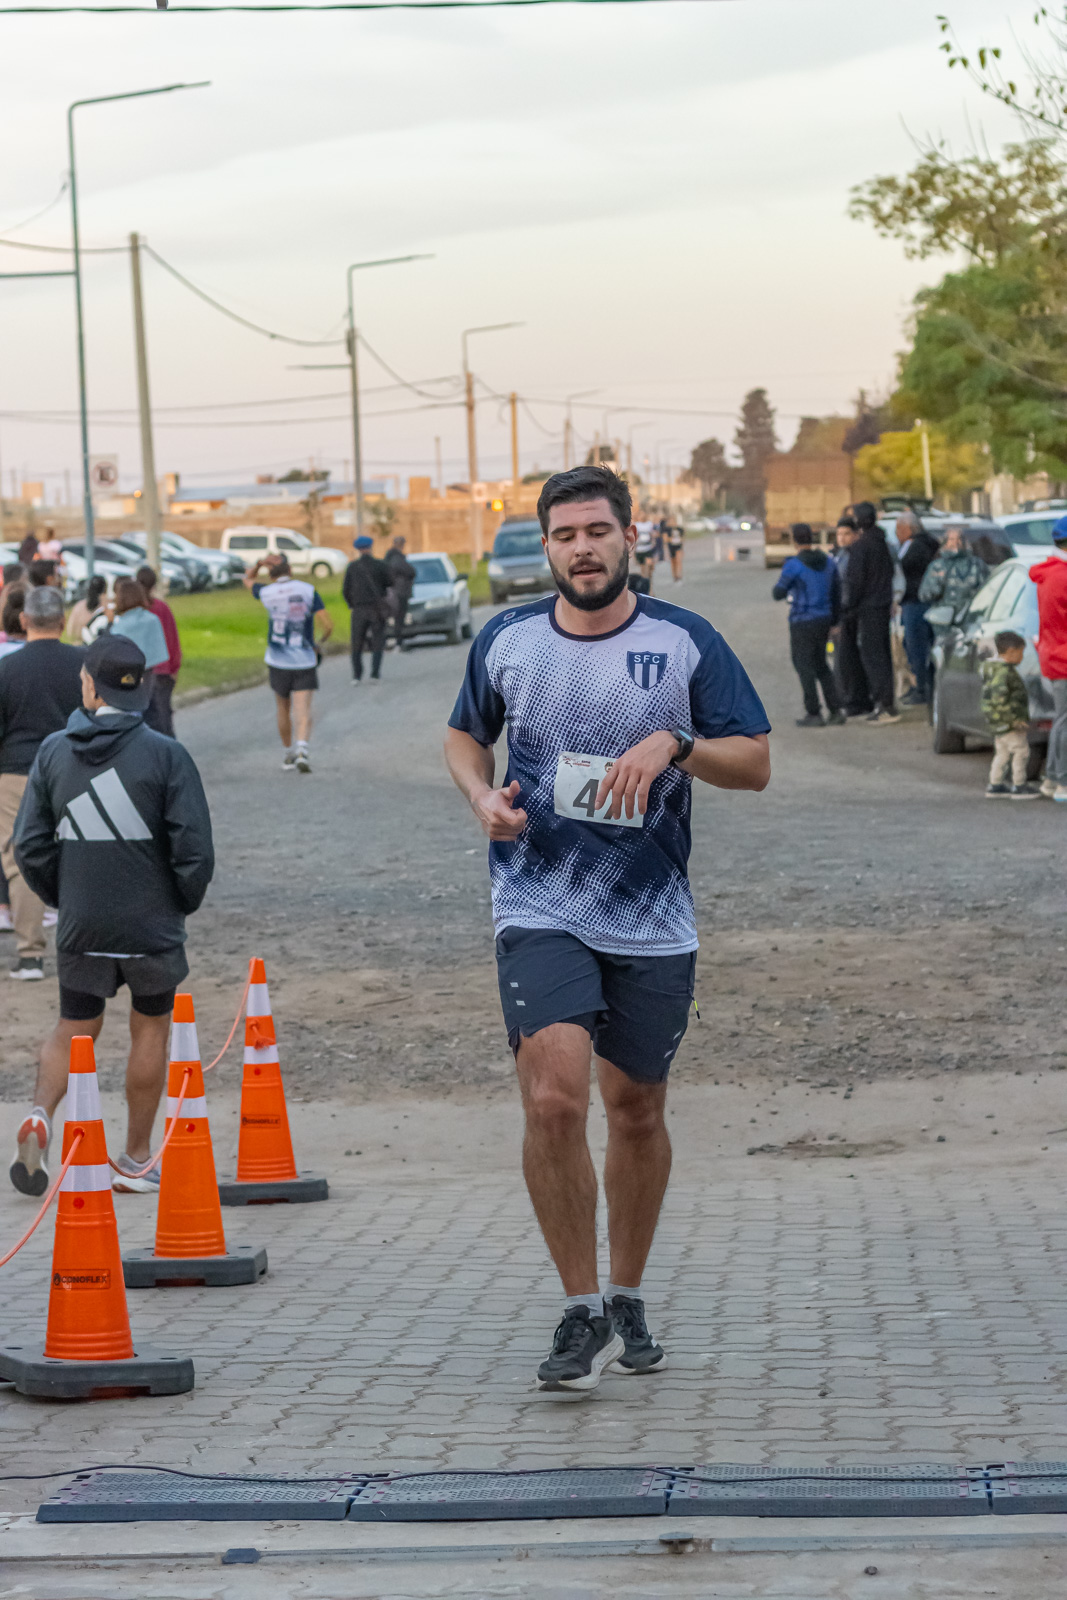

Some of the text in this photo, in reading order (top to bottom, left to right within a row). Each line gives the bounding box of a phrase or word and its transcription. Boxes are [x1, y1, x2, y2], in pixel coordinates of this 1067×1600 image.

[633, 654, 661, 664] SFC
[572, 778, 615, 820] 4
[61, 1275, 107, 1283] CONOFLEX
